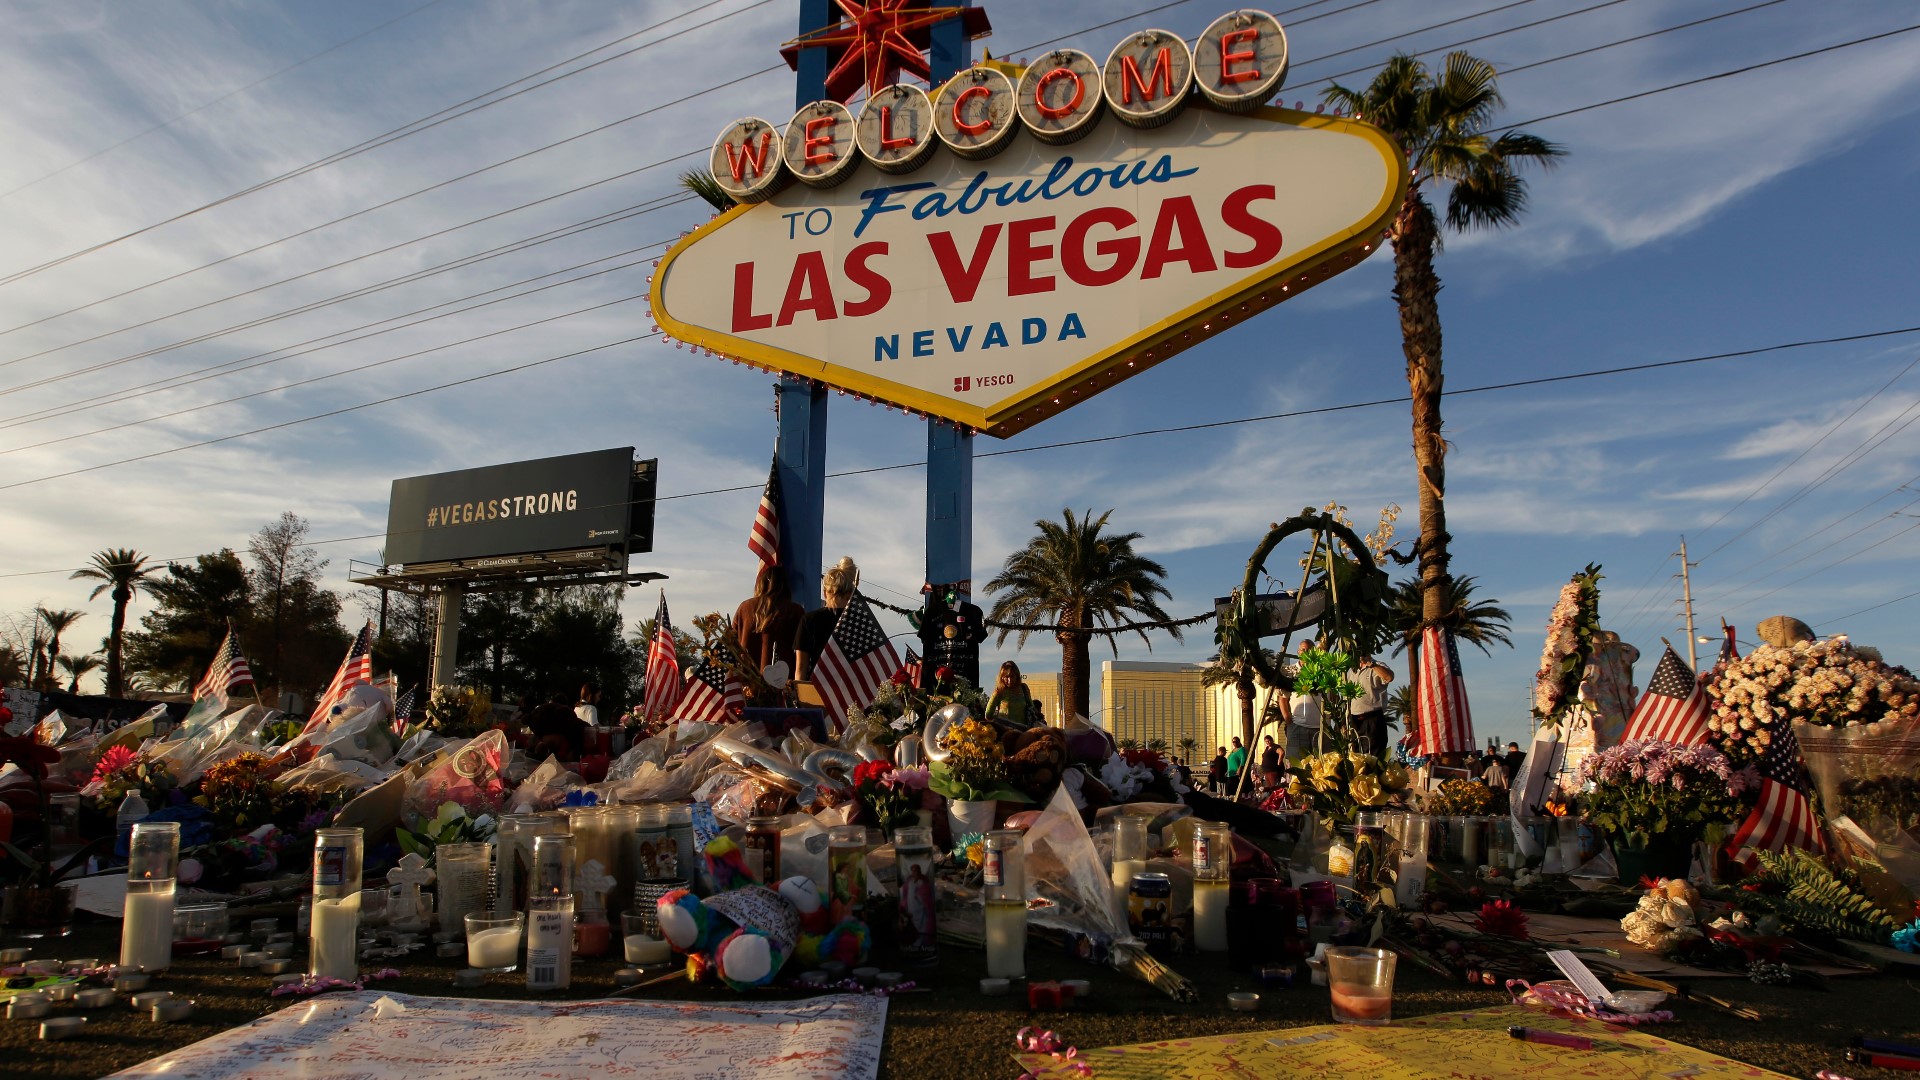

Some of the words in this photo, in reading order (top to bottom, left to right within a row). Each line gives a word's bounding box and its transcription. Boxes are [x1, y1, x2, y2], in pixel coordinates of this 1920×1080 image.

[722, 26, 1262, 184] WELCOME
[782, 208, 833, 240] TO
[853, 154, 1198, 239] Fabulous
[732, 241, 892, 334] LAS
[926, 184, 1284, 304] VEGAS
[874, 312, 1087, 362] NEVADA
[975, 373, 1015, 388] YESCO
[427, 489, 578, 528] #VEGASSTRONG
